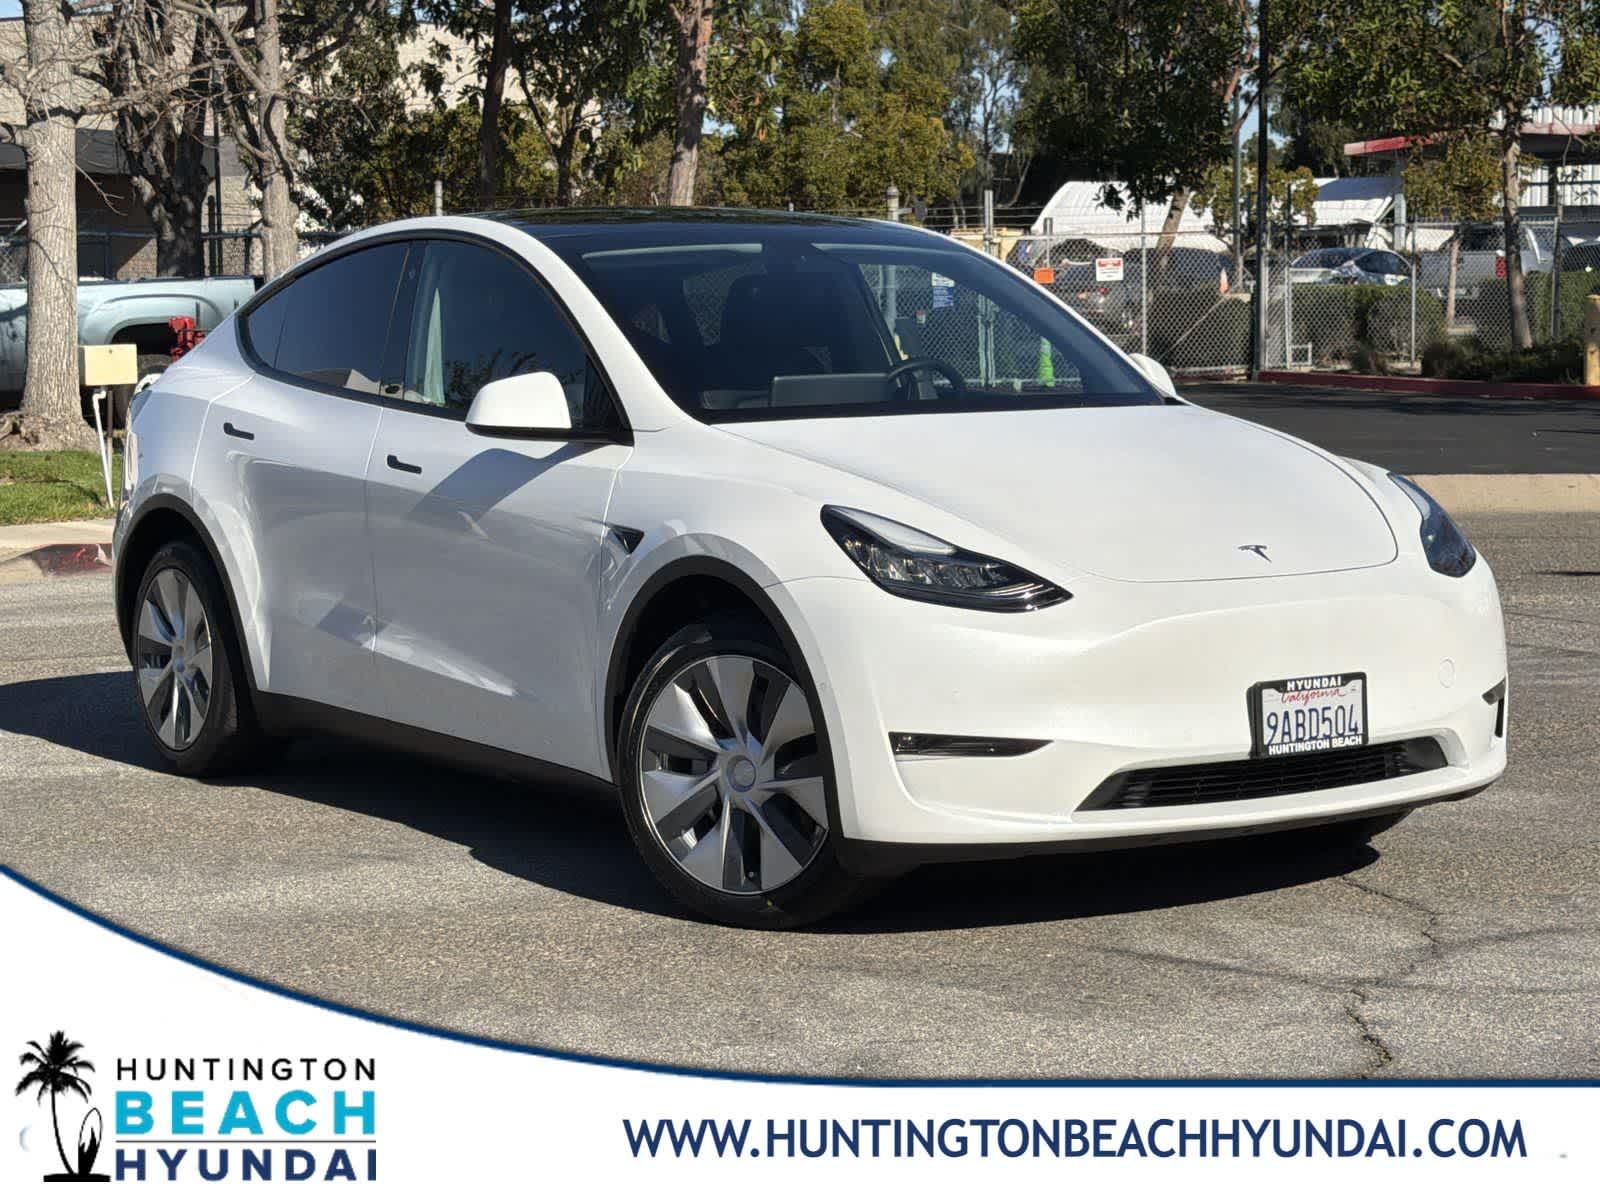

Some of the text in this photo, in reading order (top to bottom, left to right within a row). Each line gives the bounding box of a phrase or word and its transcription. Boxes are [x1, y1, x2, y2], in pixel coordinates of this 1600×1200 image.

[1287, 676, 1342, 692] HYUNDAI
[1281, 688, 1346, 706] California
[1266, 703, 1359, 746] 9ABD504
[1268, 735, 1362, 756] HUNTINGTON BEACH
